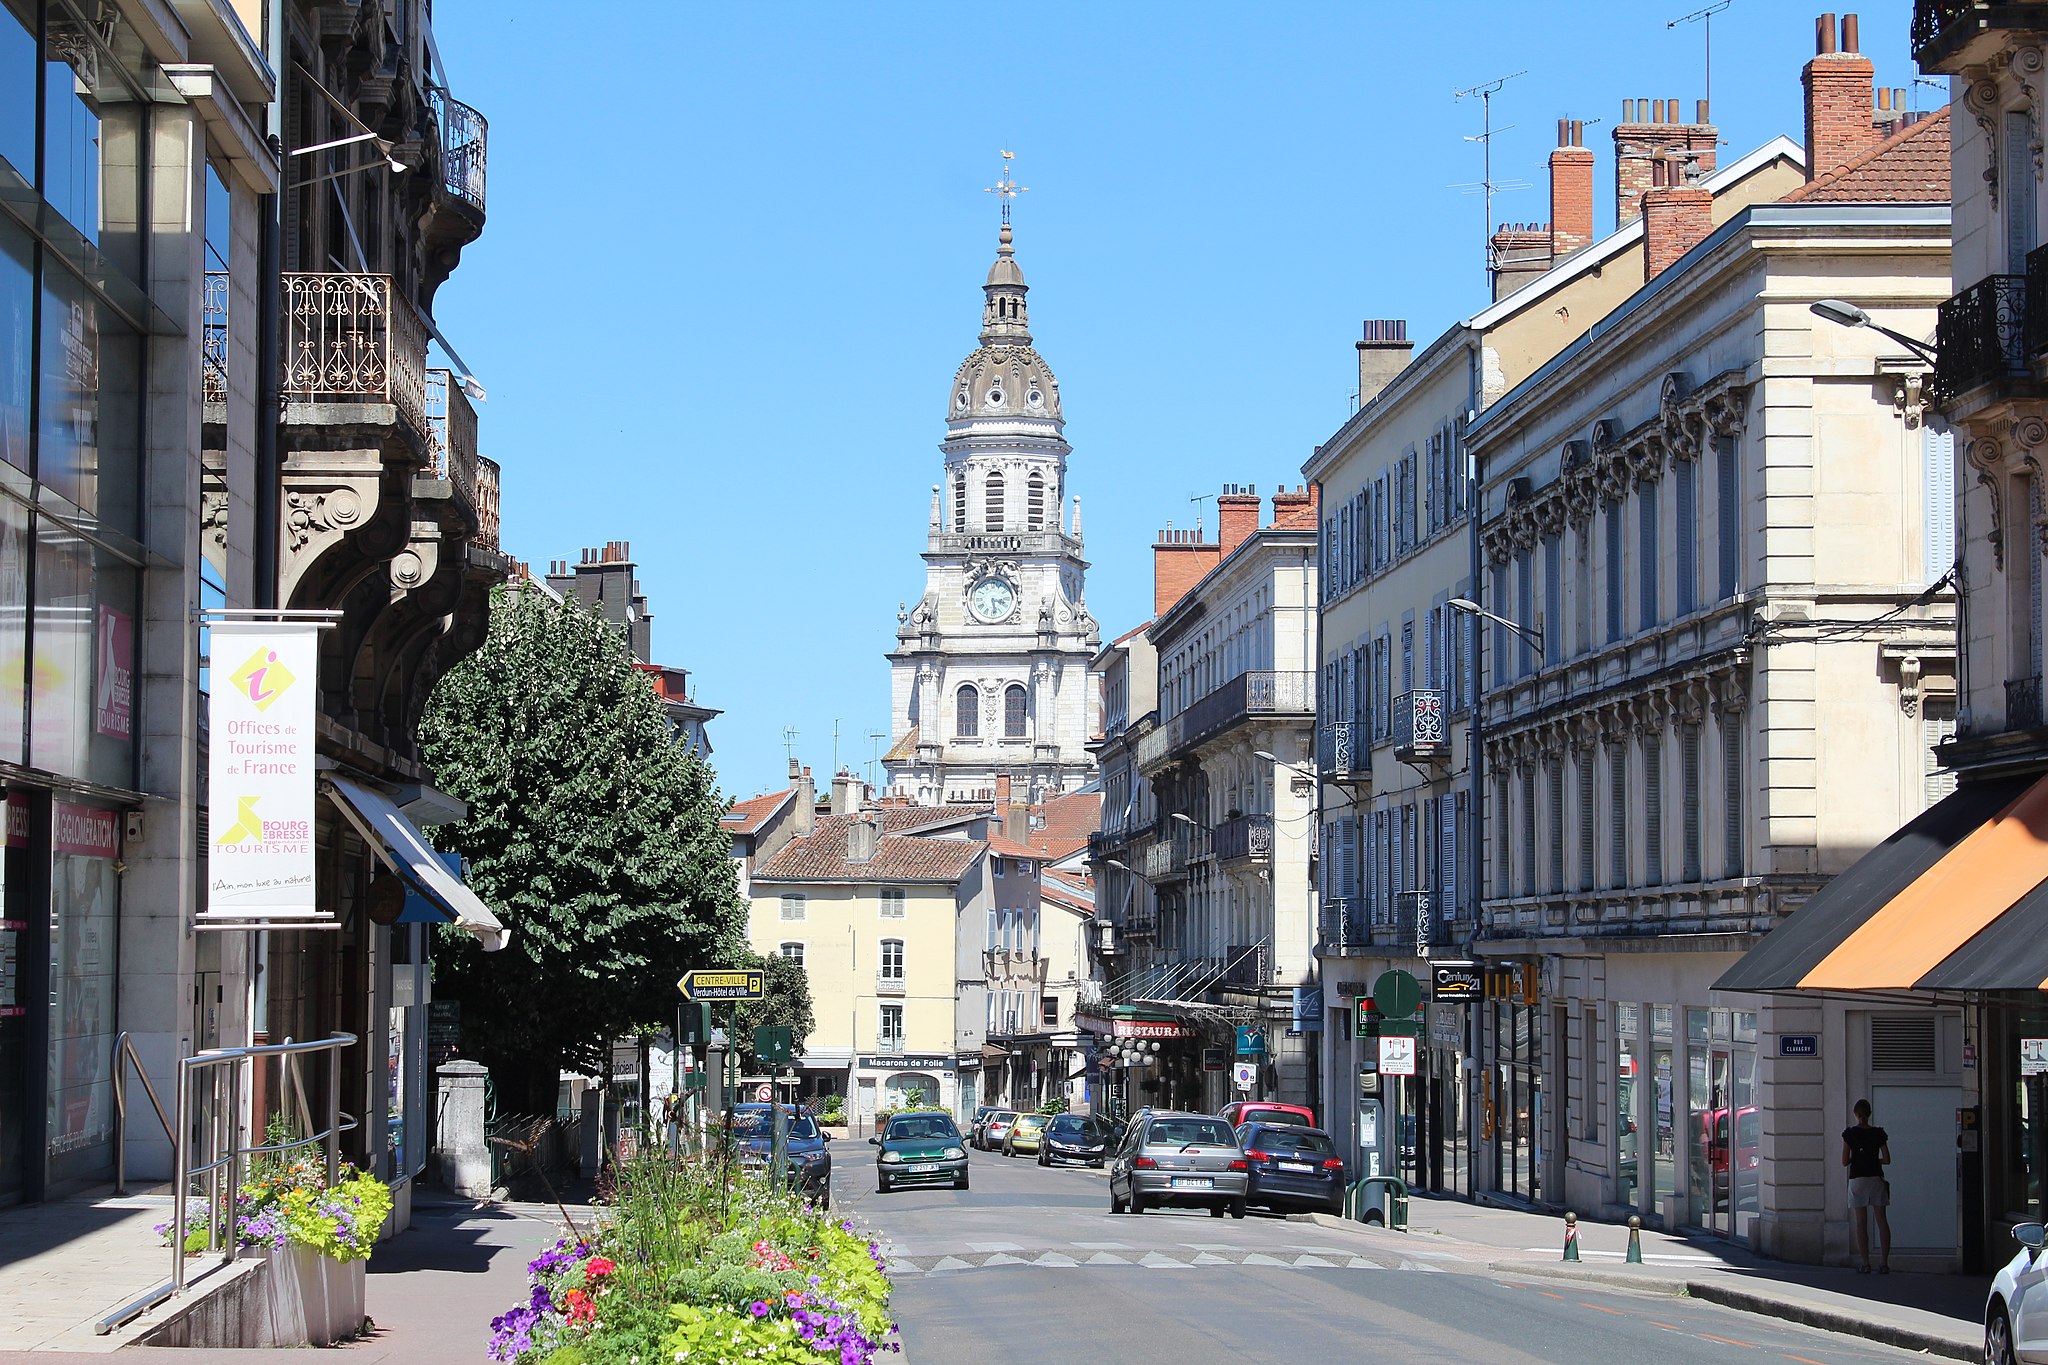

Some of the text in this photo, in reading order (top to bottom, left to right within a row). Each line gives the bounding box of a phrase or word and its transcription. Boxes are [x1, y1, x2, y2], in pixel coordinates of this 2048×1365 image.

[98, 708, 130, 734] TOURISME
[227, 720, 297, 735] Offices de
[227, 740, 297, 755] Tourisme
[227, 759, 297, 775] de France
[56, 808, 112, 849] AGGLOMÉRATION
[263, 820, 309, 831] BOURG
[269, 830, 309, 840] BRESSE
[214, 844, 309, 854] TOURISME
[256, 879, 271, 887] luxe
[273, 878, 282, 886] au
[284, 874, 312, 884] naturel
[695, 975, 746, 985] CENTRE-VILLE
[751, 979, 758, 990] P
[1437, 969, 1481, 991] Century 21
[693, 987, 748, 997] Verdun-Hôtel de Ville
[869, 1058, 944, 1067] Macarons de Folie
